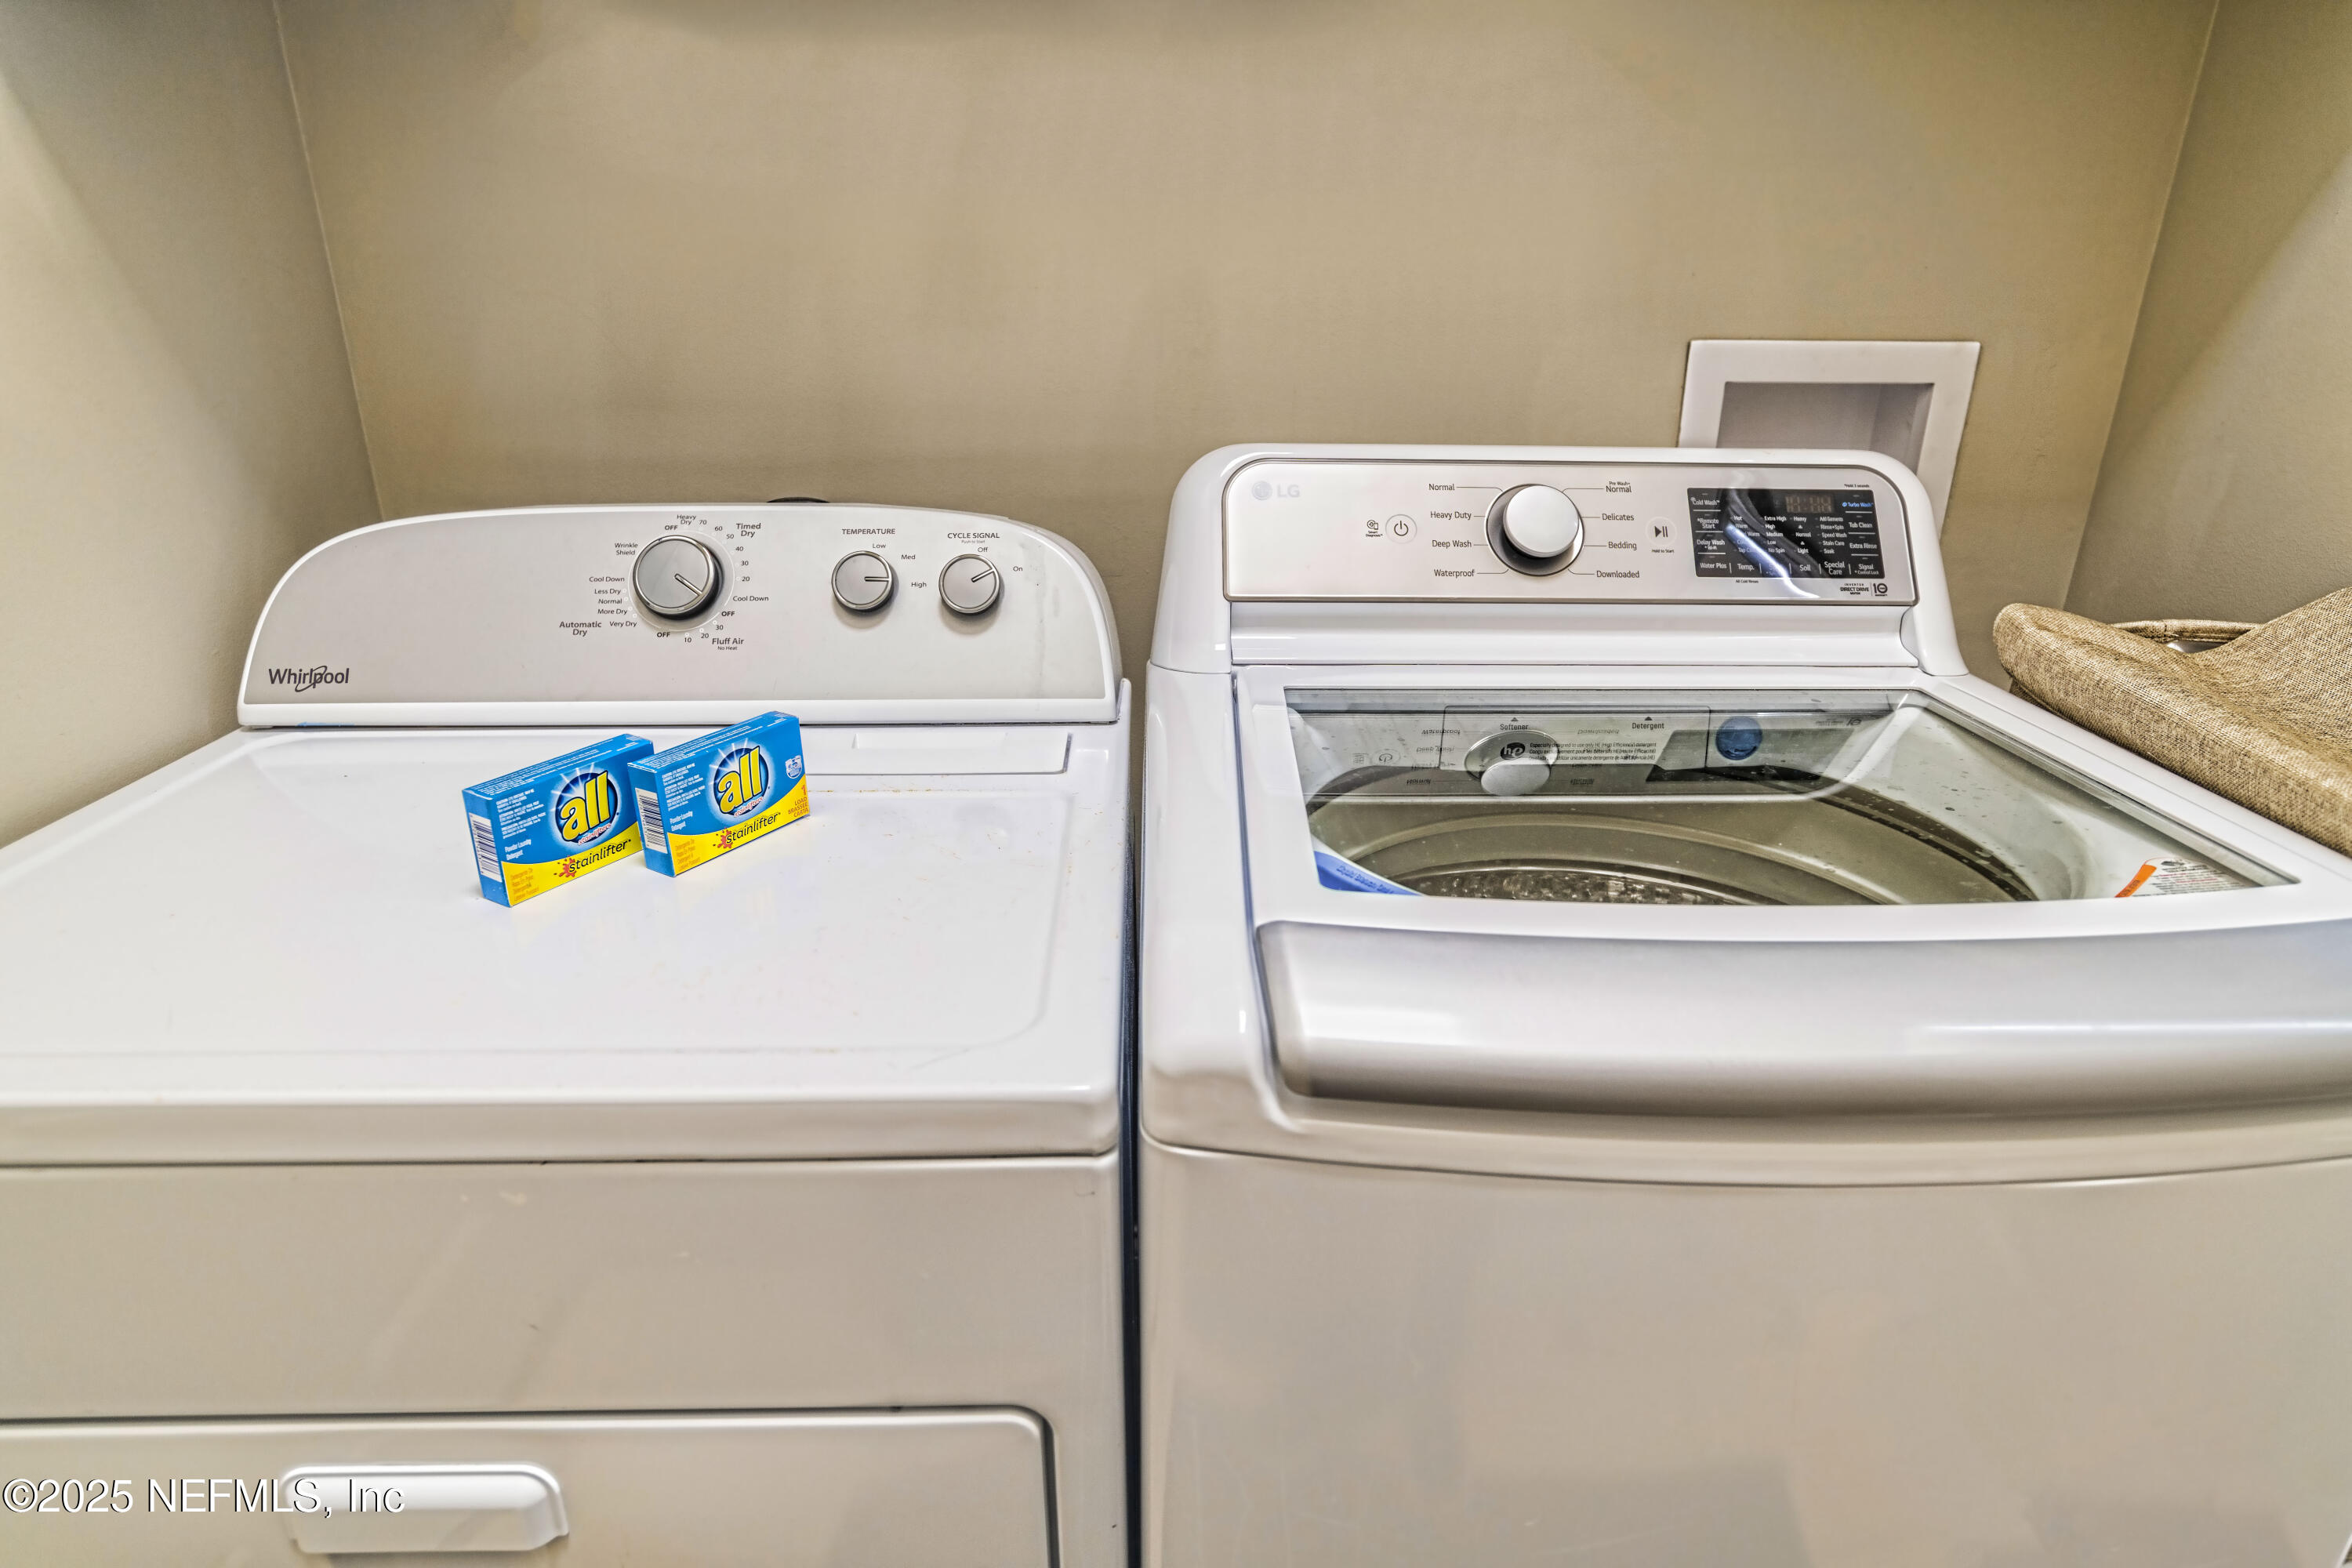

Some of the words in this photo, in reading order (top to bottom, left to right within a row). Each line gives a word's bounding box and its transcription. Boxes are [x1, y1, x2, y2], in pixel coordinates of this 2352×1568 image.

[1277, 485, 1300, 498] LG
[1430, 511, 1452, 520] Heavy
[1454, 511, 1472, 520] Duty
[1602, 513, 1634, 521] Delicates
[740, 530, 755, 538] Dry
[1432, 540, 1451, 549] Deep
[1608, 541, 1637, 551] Bedding
[1434, 569, 1475, 578] Waterproof
[1596, 570, 1640, 578] Downloaded
[572, 629, 587, 637] Dry
[268, 666, 350, 691] Whirlpool
[1632, 722, 1664, 730] Detergent
[718, 745, 762, 815] all
[802, 785, 806, 795] 1
[560, 770, 610, 841] all
[795, 797, 807, 806] LOAD
[734, 796, 764, 817] stainlifters
[794, 808, 809, 817] CARTA
[726, 813, 779, 844] stainlifter
[578, 822, 612, 846] stainlifters
[569, 841, 628, 872] stainlifter
